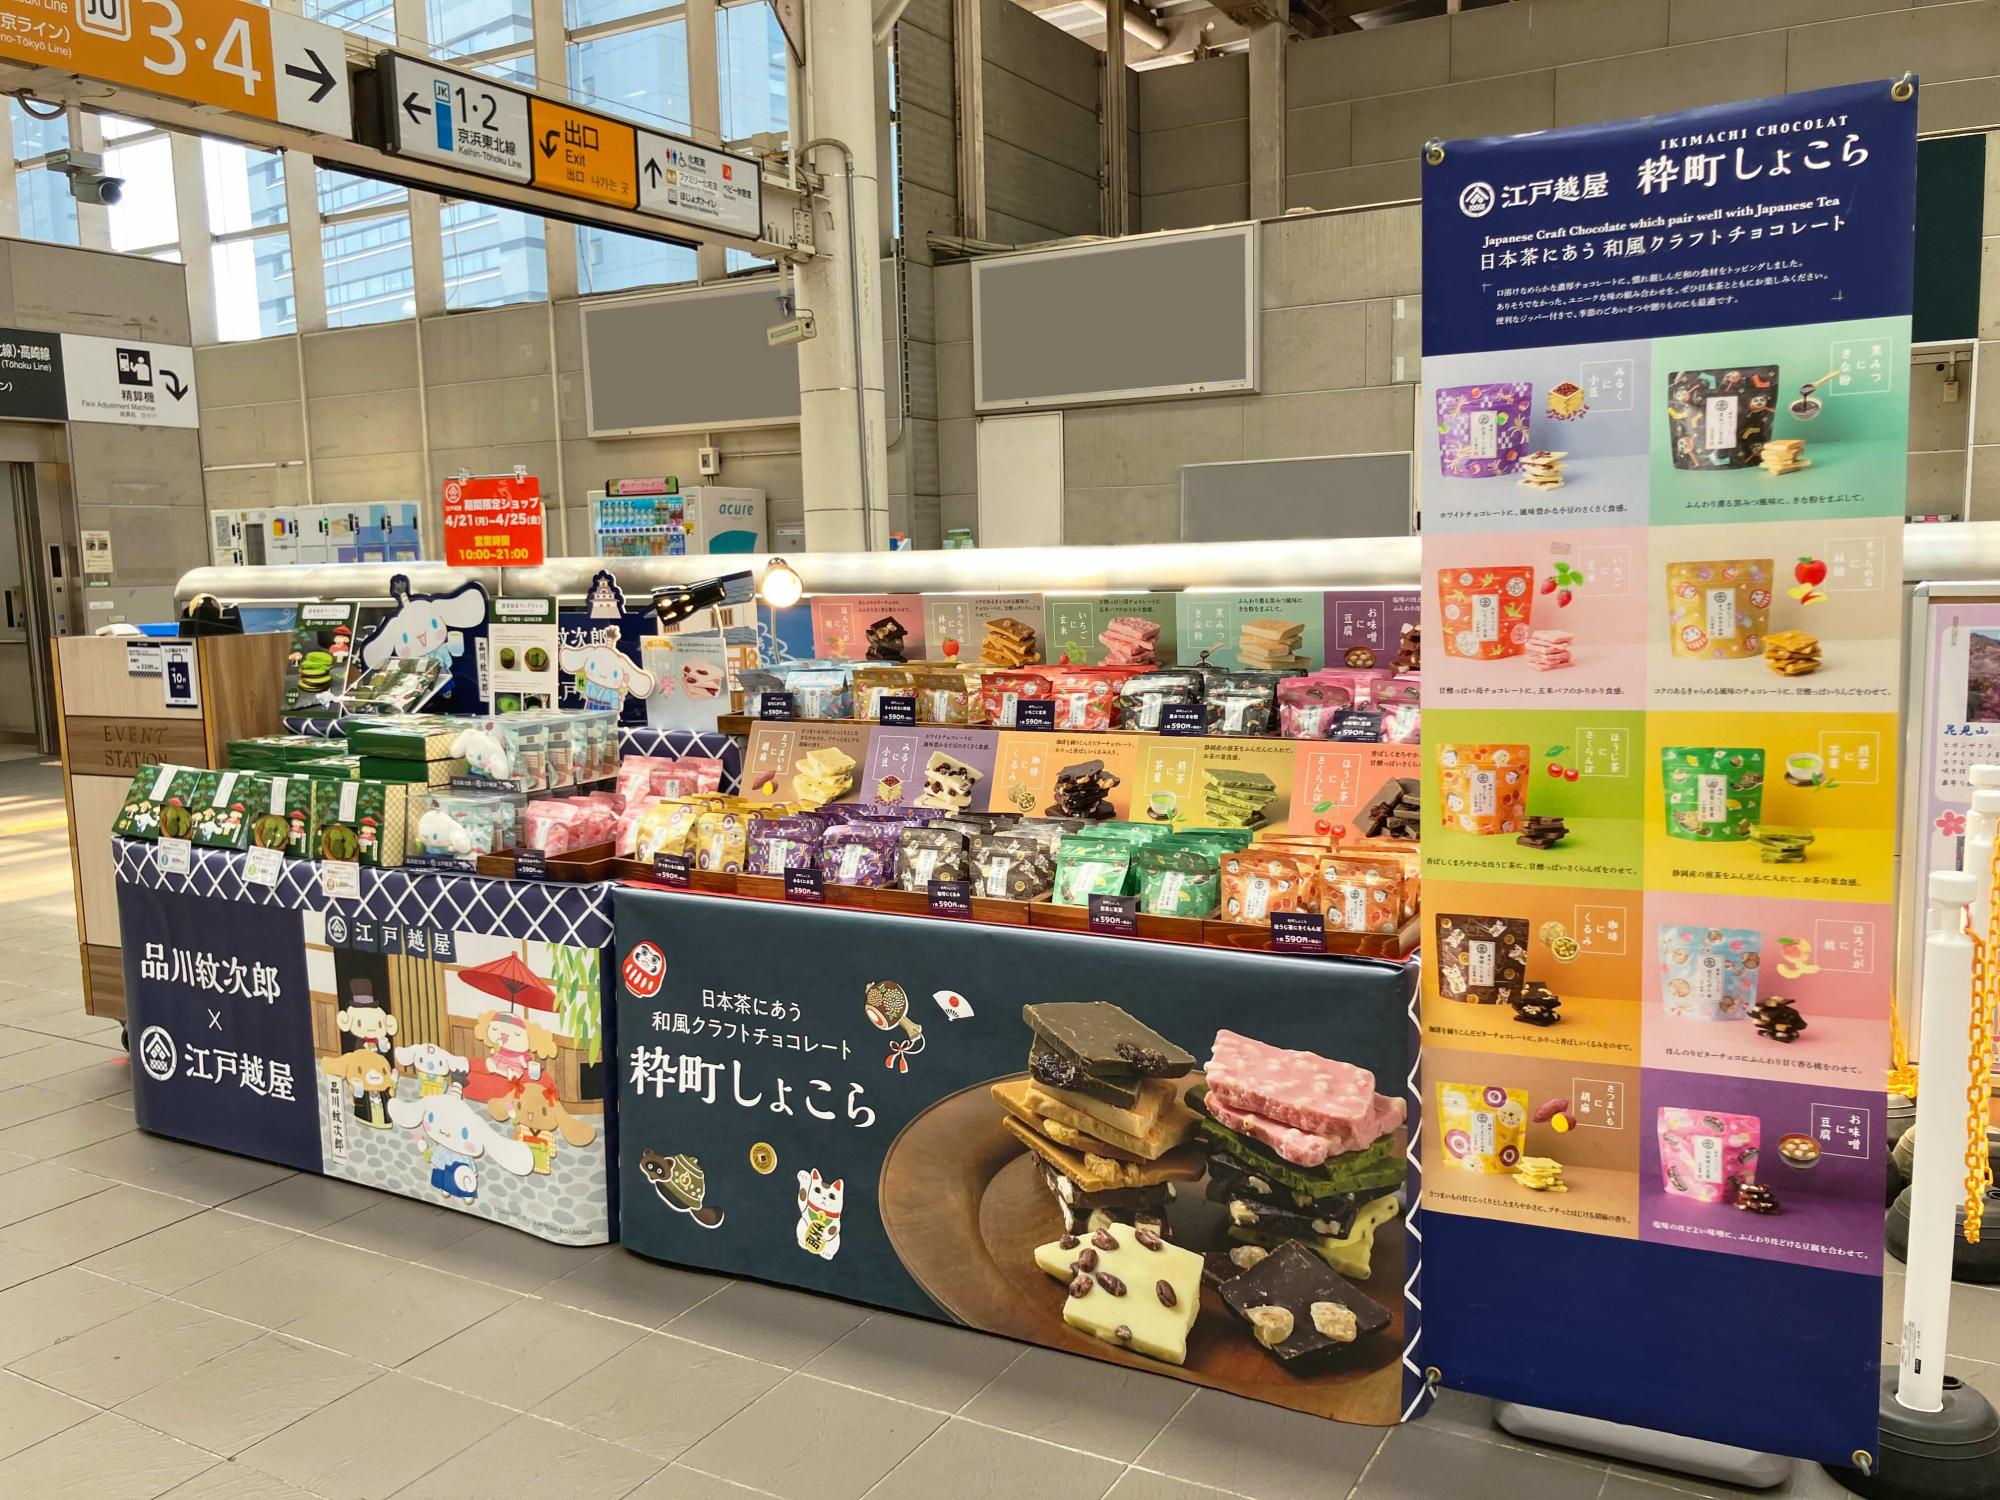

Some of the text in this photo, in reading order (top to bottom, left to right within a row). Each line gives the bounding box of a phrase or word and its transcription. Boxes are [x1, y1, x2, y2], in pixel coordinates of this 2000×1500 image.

[435, 85, 449, 99] JK
[457, 127, 517, 157] 京浜東北線
[564, 119, 599, 151] 出口
[1660, 114, 1850, 151] IKIMACHI CHOCOLAT
[507, 156, 523, 170] Line
[565, 149, 587, 167] Exit
[1501, 132, 1870, 210] 江戸越屋 粋町しょこら
[565, 167, 586, 184] 出口
[1482, 196, 1841, 249] Japanese Craft Chocolate which pair well with Japanese Tea
[1480, 214, 1847, 272] 日本茶にあう 和風クラフトチョコレート
[81, 399, 156, 412] Fare Adjustment Machine
[121, 389, 156, 404] 精算機
[719, 502, 754, 516] acure
[1060, 614, 1069, 636] 玄米
[1078, 610, 1088, 640] いちご
[1343, 613, 1354, 638] 豆腐
[1366, 607, 1378, 644] お味噌
[103, 724, 169, 745] EVENT
[1171, 722, 1191, 730] 590円
[1943, 724, 1989, 736] 花見山
[104, 750, 168, 770] STATION
[900, 743, 911, 774] みるく
[1339, 758, 1352, 802] ほうじ茶
[661, 871, 679, 881] 590円
[794, 886, 811, 896] 590円
[938, 900, 958, 909] 590円
[1100, 914, 1121, 925] 590円
[354, 921, 452, 956] 江戸越屋
[1284, 934, 1309, 944] 590円
[1582, 912, 1593, 946] くるみ
[1852, 925, 1865, 970] ほろにが
[140, 942, 282, 1005] 品川紋次郎
[702, 988, 801, 1023] 日本茶にあう
[651, 1010, 852, 1061] 和風クラフトチョコレート
[184, 1042, 297, 1102] 江戸越屋
[629, 1045, 877, 1129] 粋町しょこら
[329, 1079, 345, 1154] 品川紋次郎
[1605, 1083, 1616, 1127] さつまいも
[1818, 1115, 1833, 1142] 豆腐
[1847, 1114, 1862, 1151] お味噌
